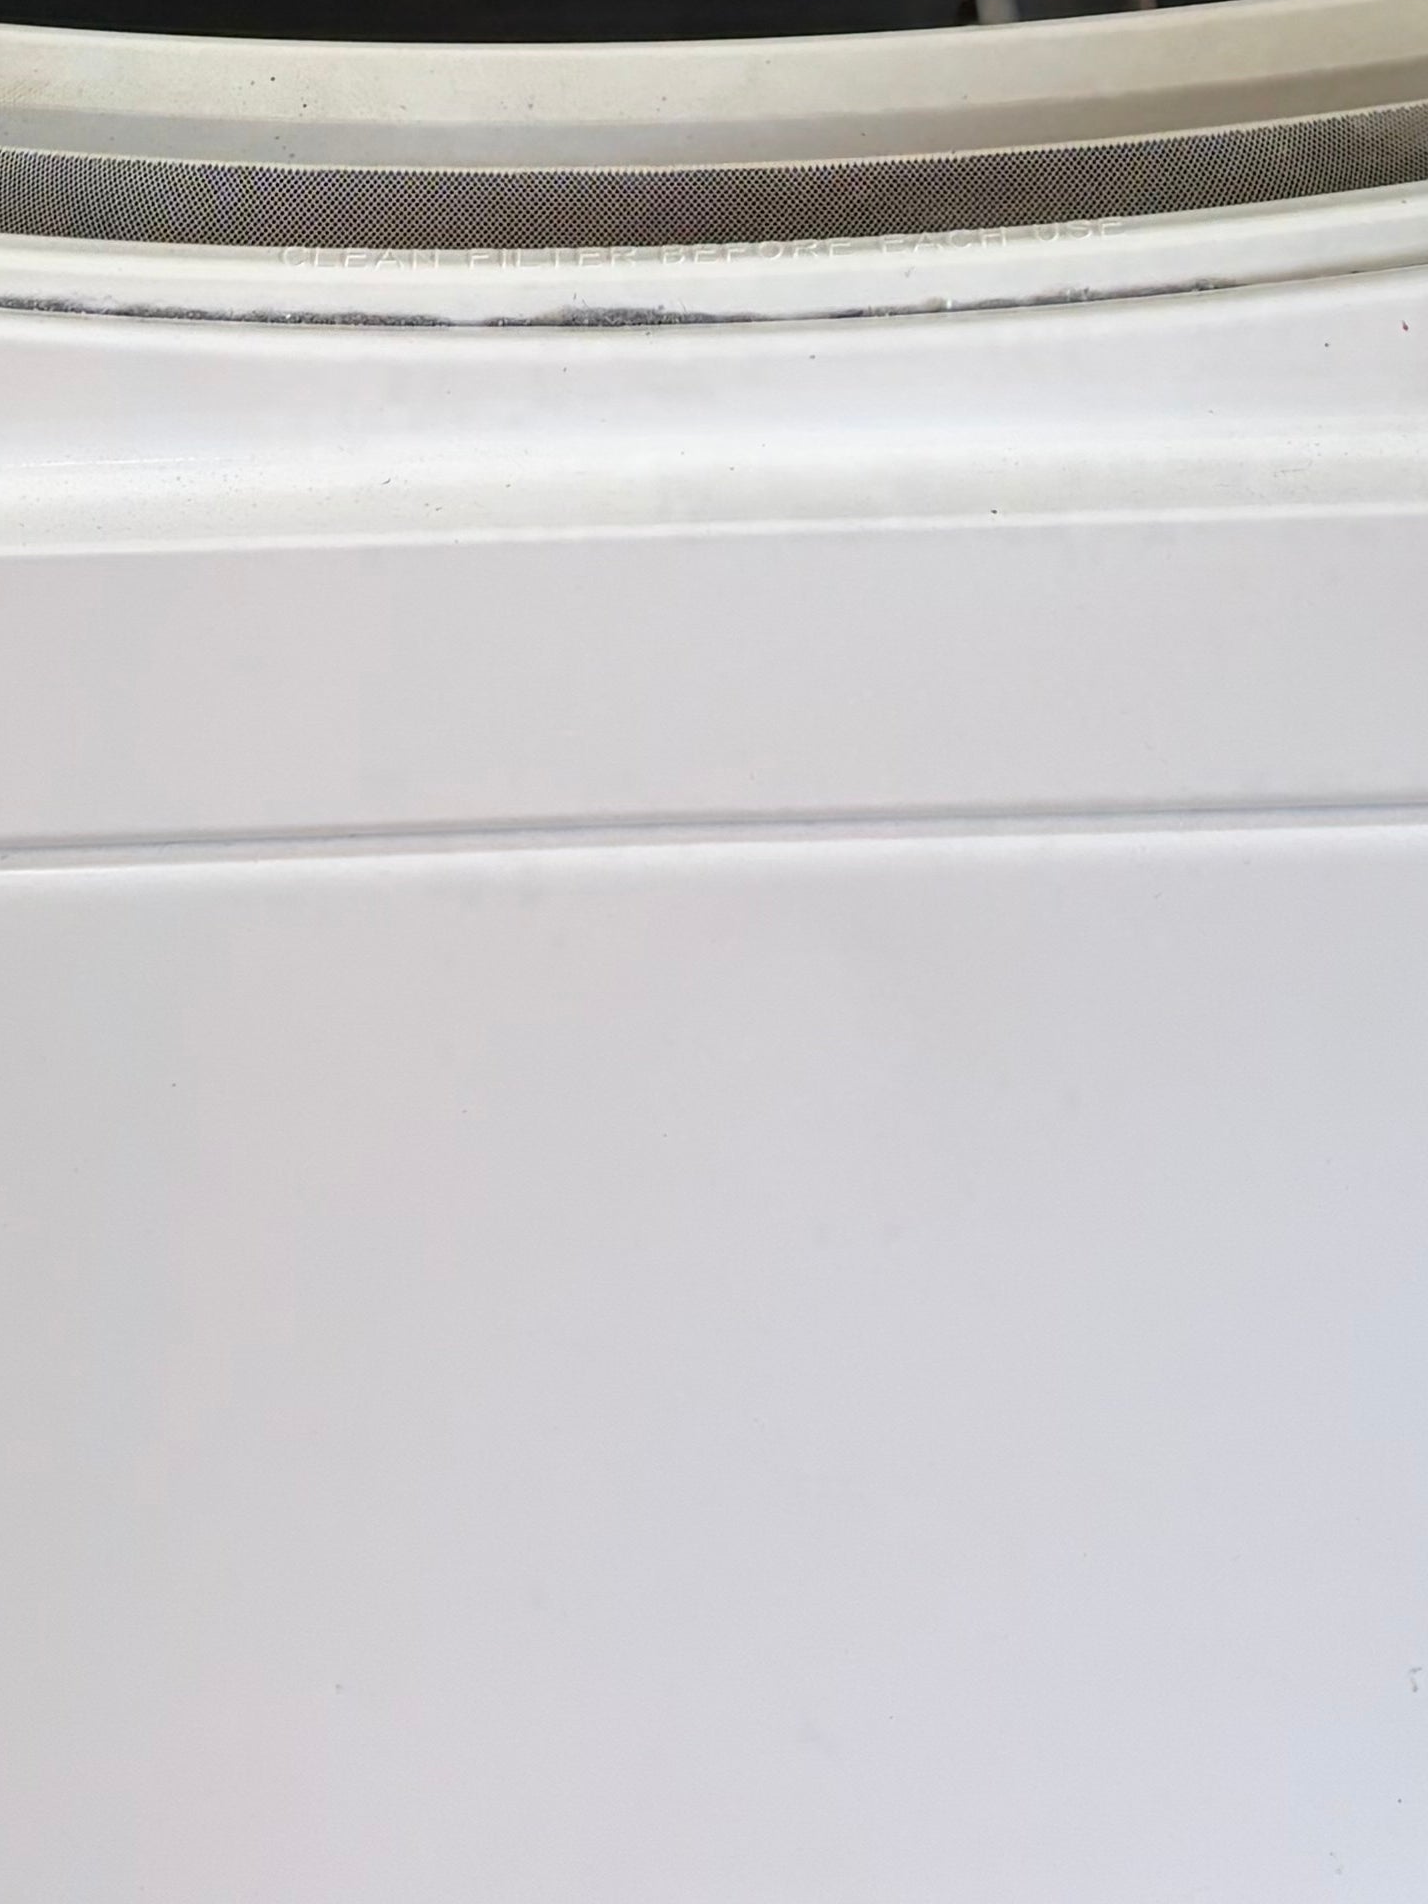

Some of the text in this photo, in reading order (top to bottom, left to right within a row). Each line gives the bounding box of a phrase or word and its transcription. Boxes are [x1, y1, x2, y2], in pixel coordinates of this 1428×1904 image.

[280, 219, 1123, 272] CLEAN FILTER BEFORE EACH USE
